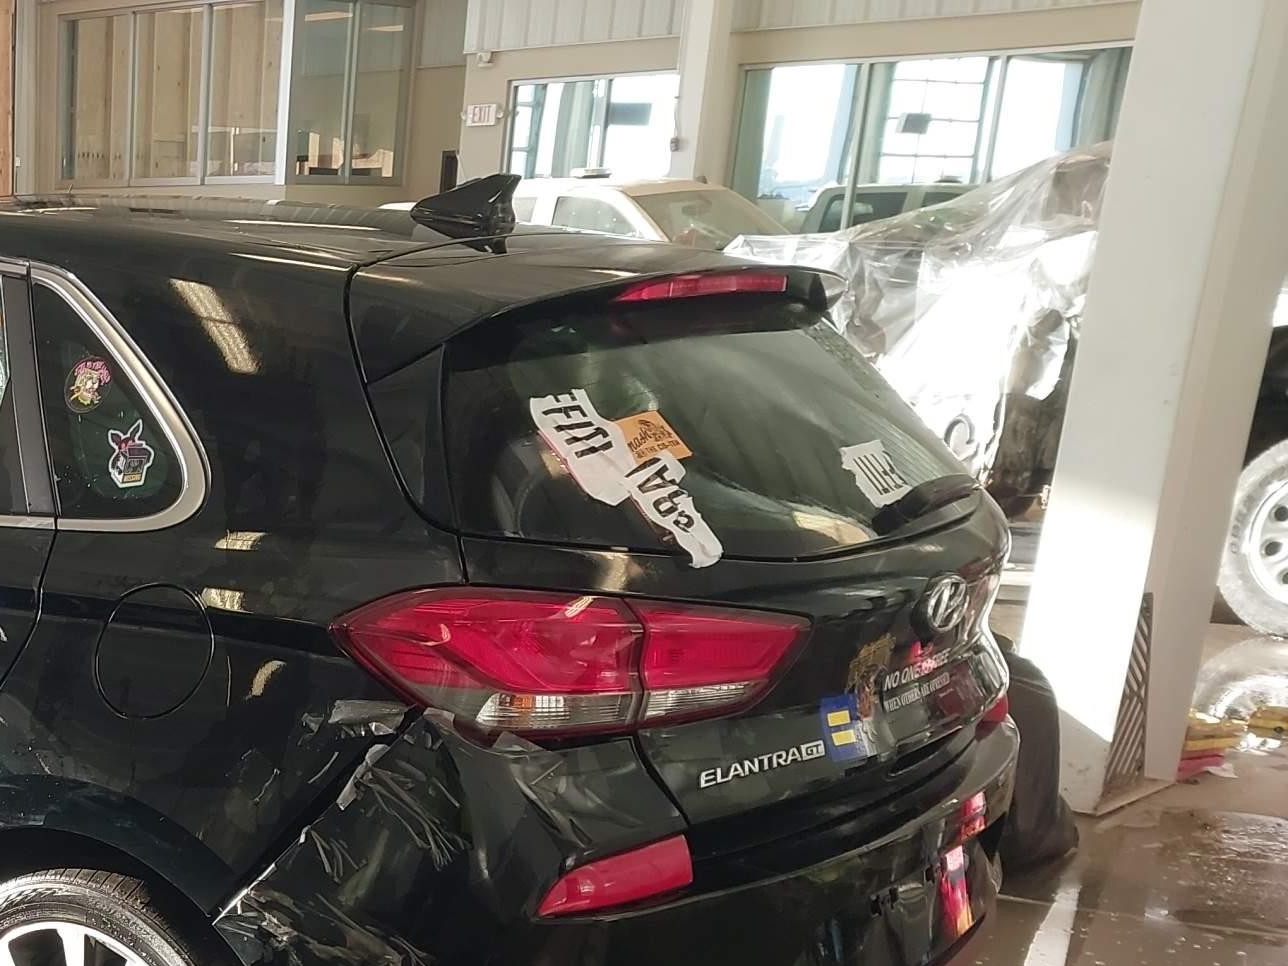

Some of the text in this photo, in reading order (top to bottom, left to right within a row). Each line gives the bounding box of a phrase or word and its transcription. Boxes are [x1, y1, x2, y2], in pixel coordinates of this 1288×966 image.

[471, 105, 493, 124] EXIT
[884, 671, 900, 691] NO
[700, 741, 824, 789] ELANTRA GT
